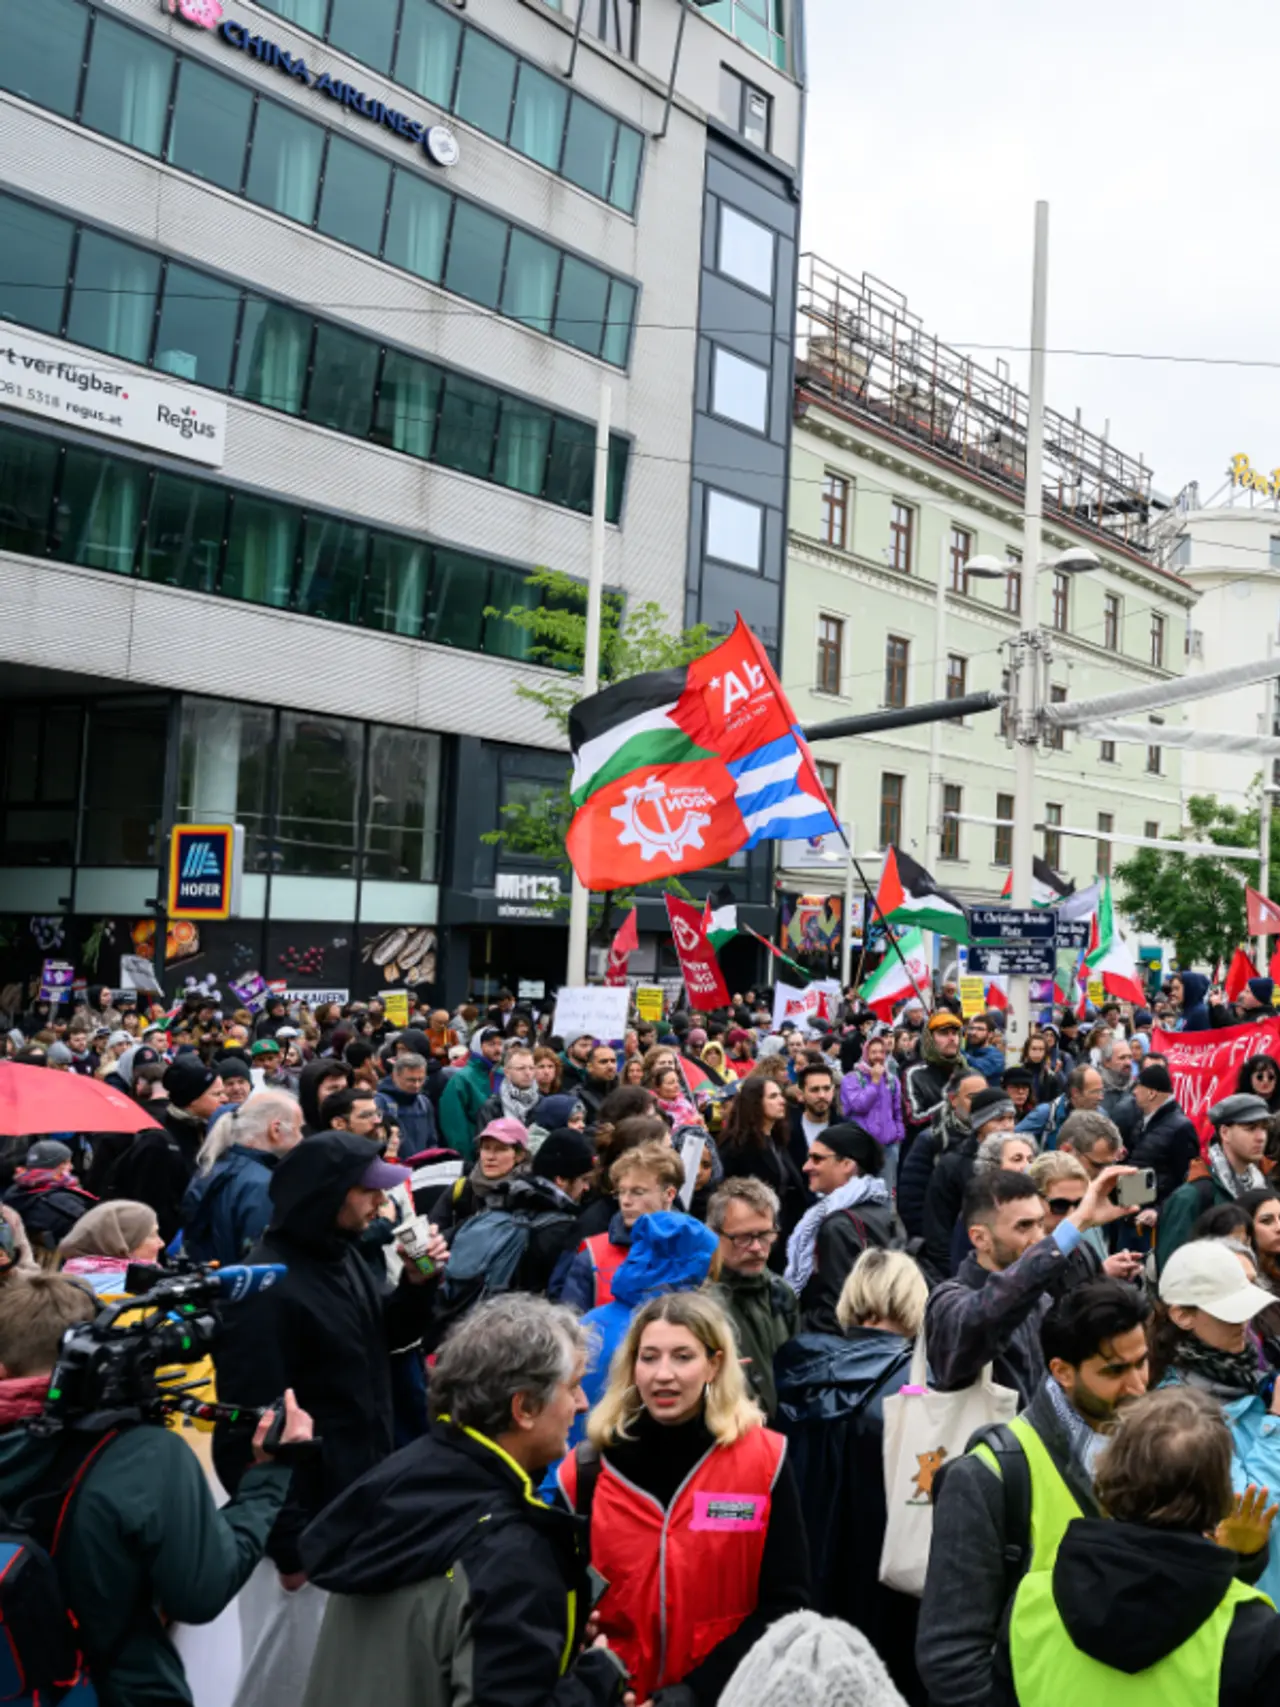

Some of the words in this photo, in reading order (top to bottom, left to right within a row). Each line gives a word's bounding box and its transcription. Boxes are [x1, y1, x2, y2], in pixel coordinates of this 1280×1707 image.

[221, 20, 310, 84] CHINA
[316, 72, 424, 144] AIRLINES
[22, 356, 129, 400] verfügbar.
[66, 401, 123, 427] regus.at
[157, 404, 216, 439] Regus
[181, 882, 221, 897] HOFER
